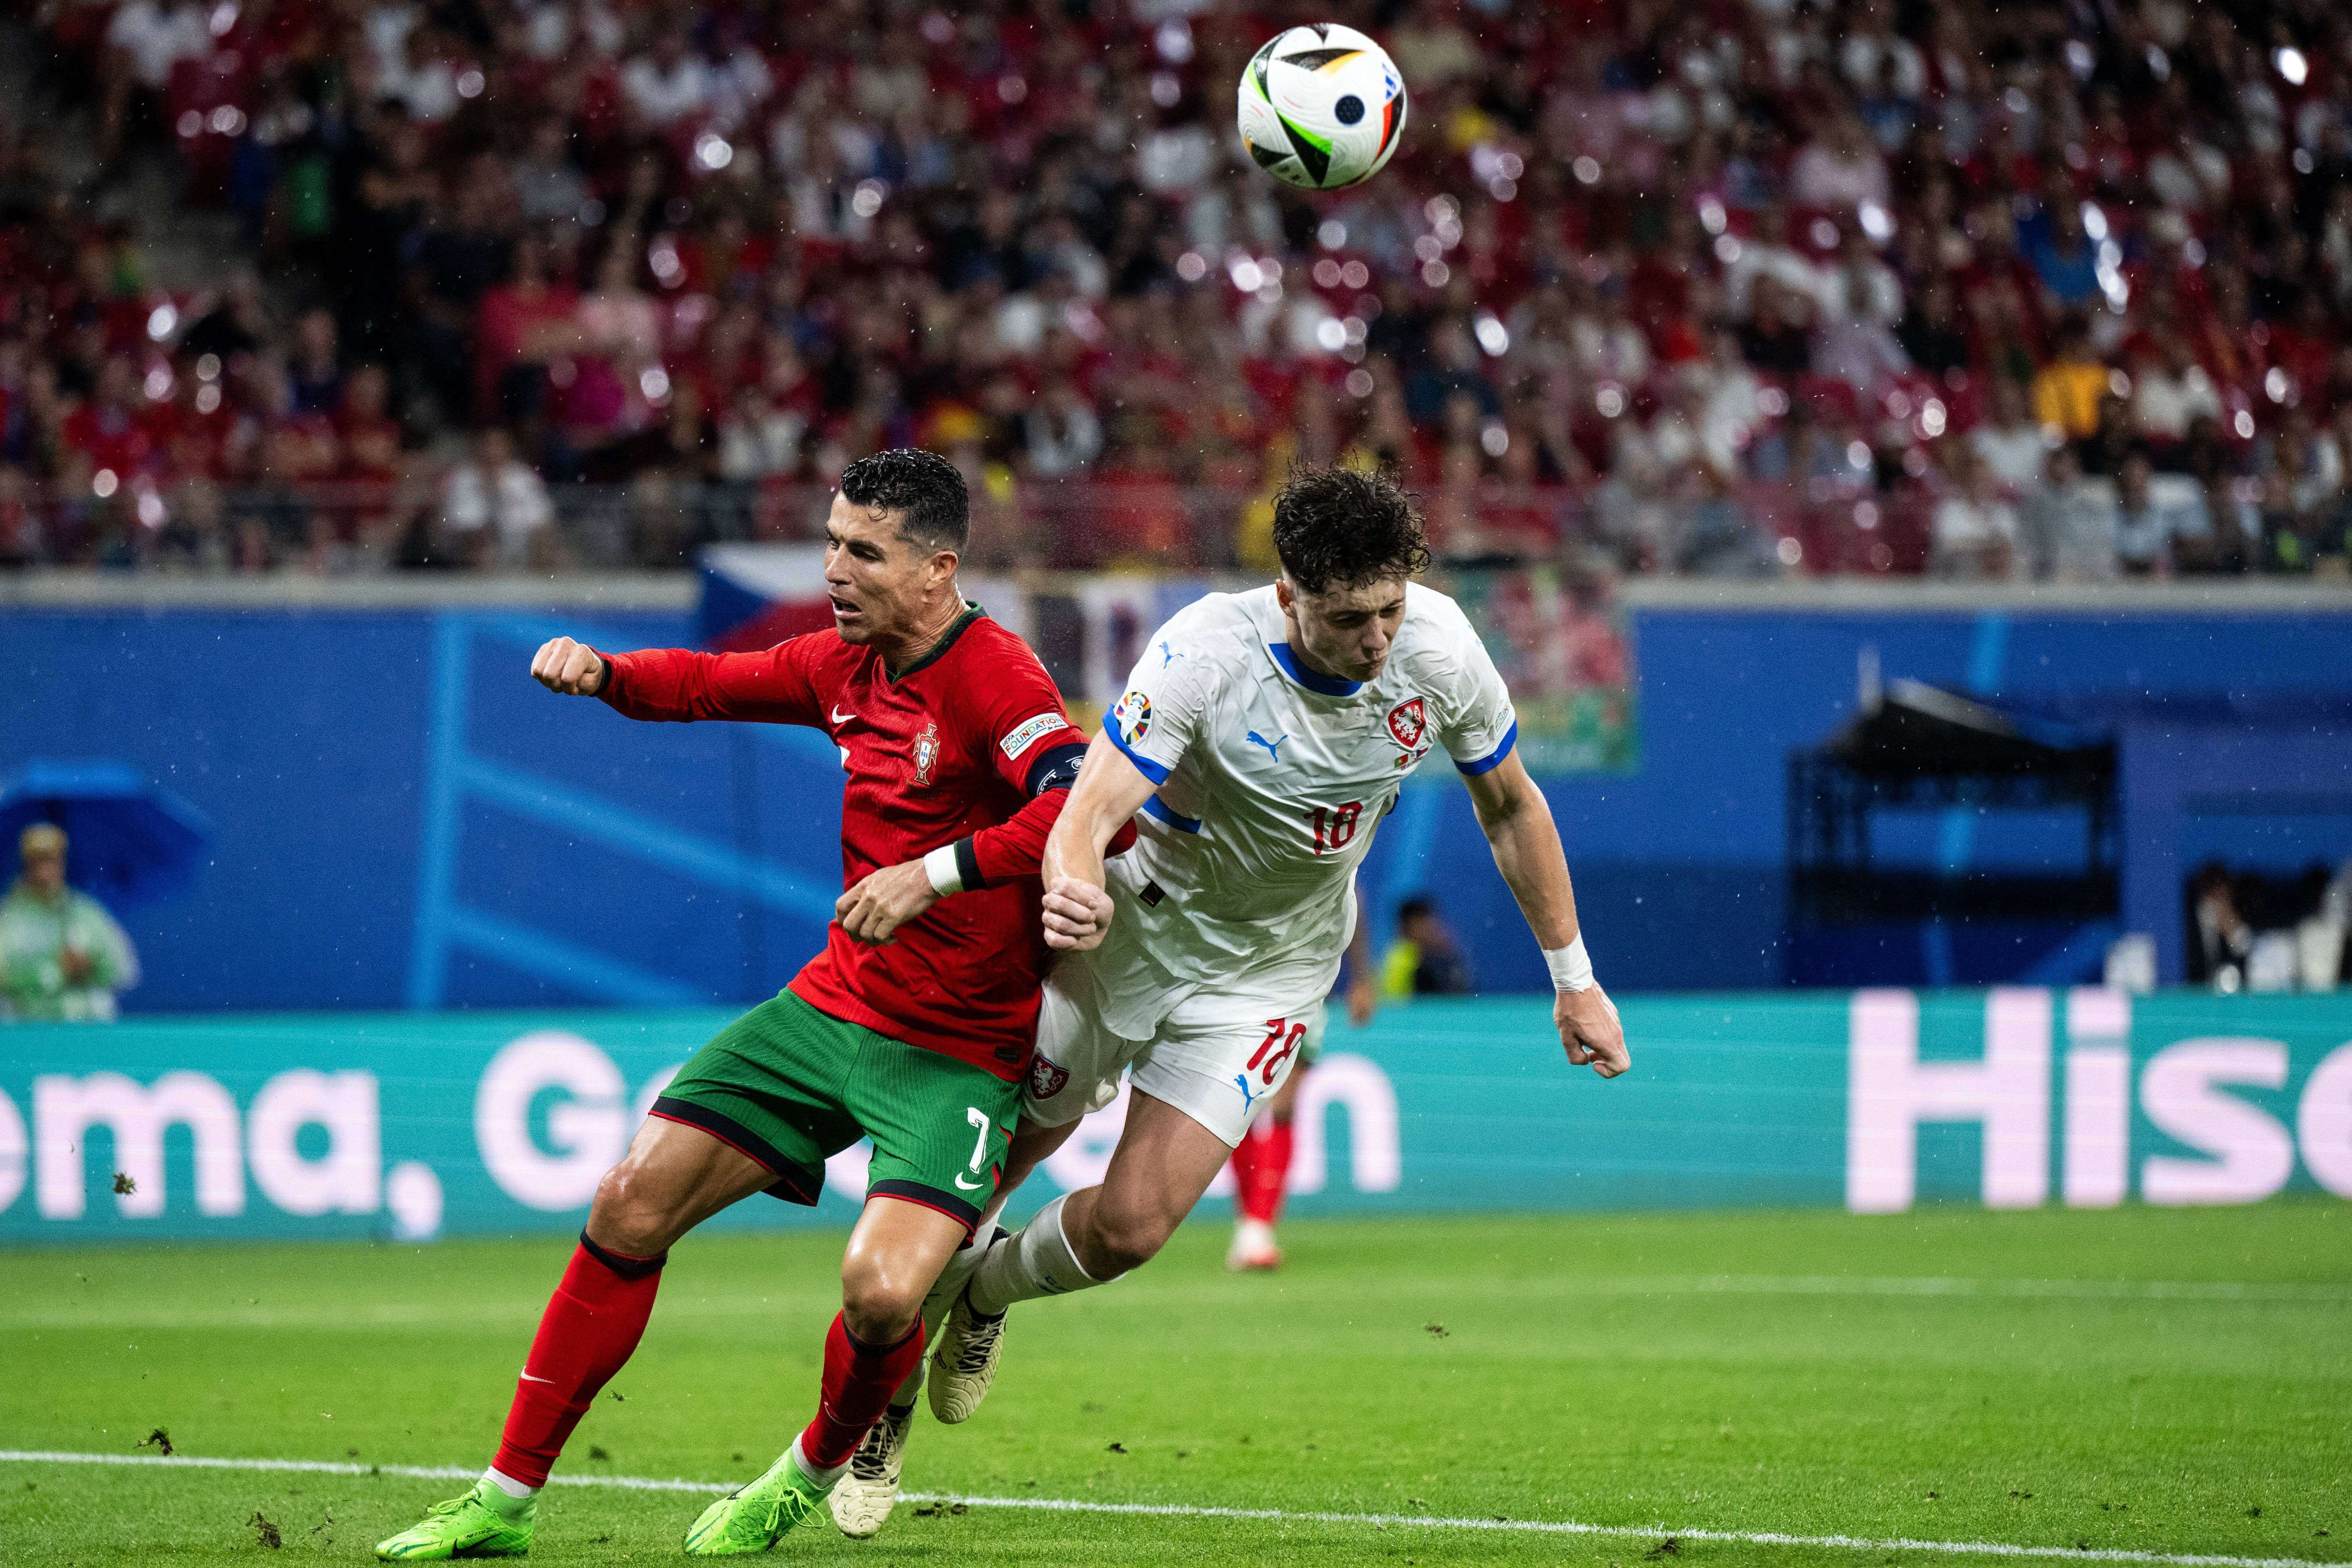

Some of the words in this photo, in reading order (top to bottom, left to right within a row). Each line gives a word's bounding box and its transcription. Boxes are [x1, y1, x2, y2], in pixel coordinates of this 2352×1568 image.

[1002, 734, 1015, 746] UEFA
[1005, 718, 1063, 753] FOUNDATION
[1304, 801, 1364, 855] 18
[1247, 1017, 1307, 1085] 18
[0, 1067, 444, 1238] ma,
[473, 1029, 690, 1211] G
[967, 1107, 990, 1174] 7
